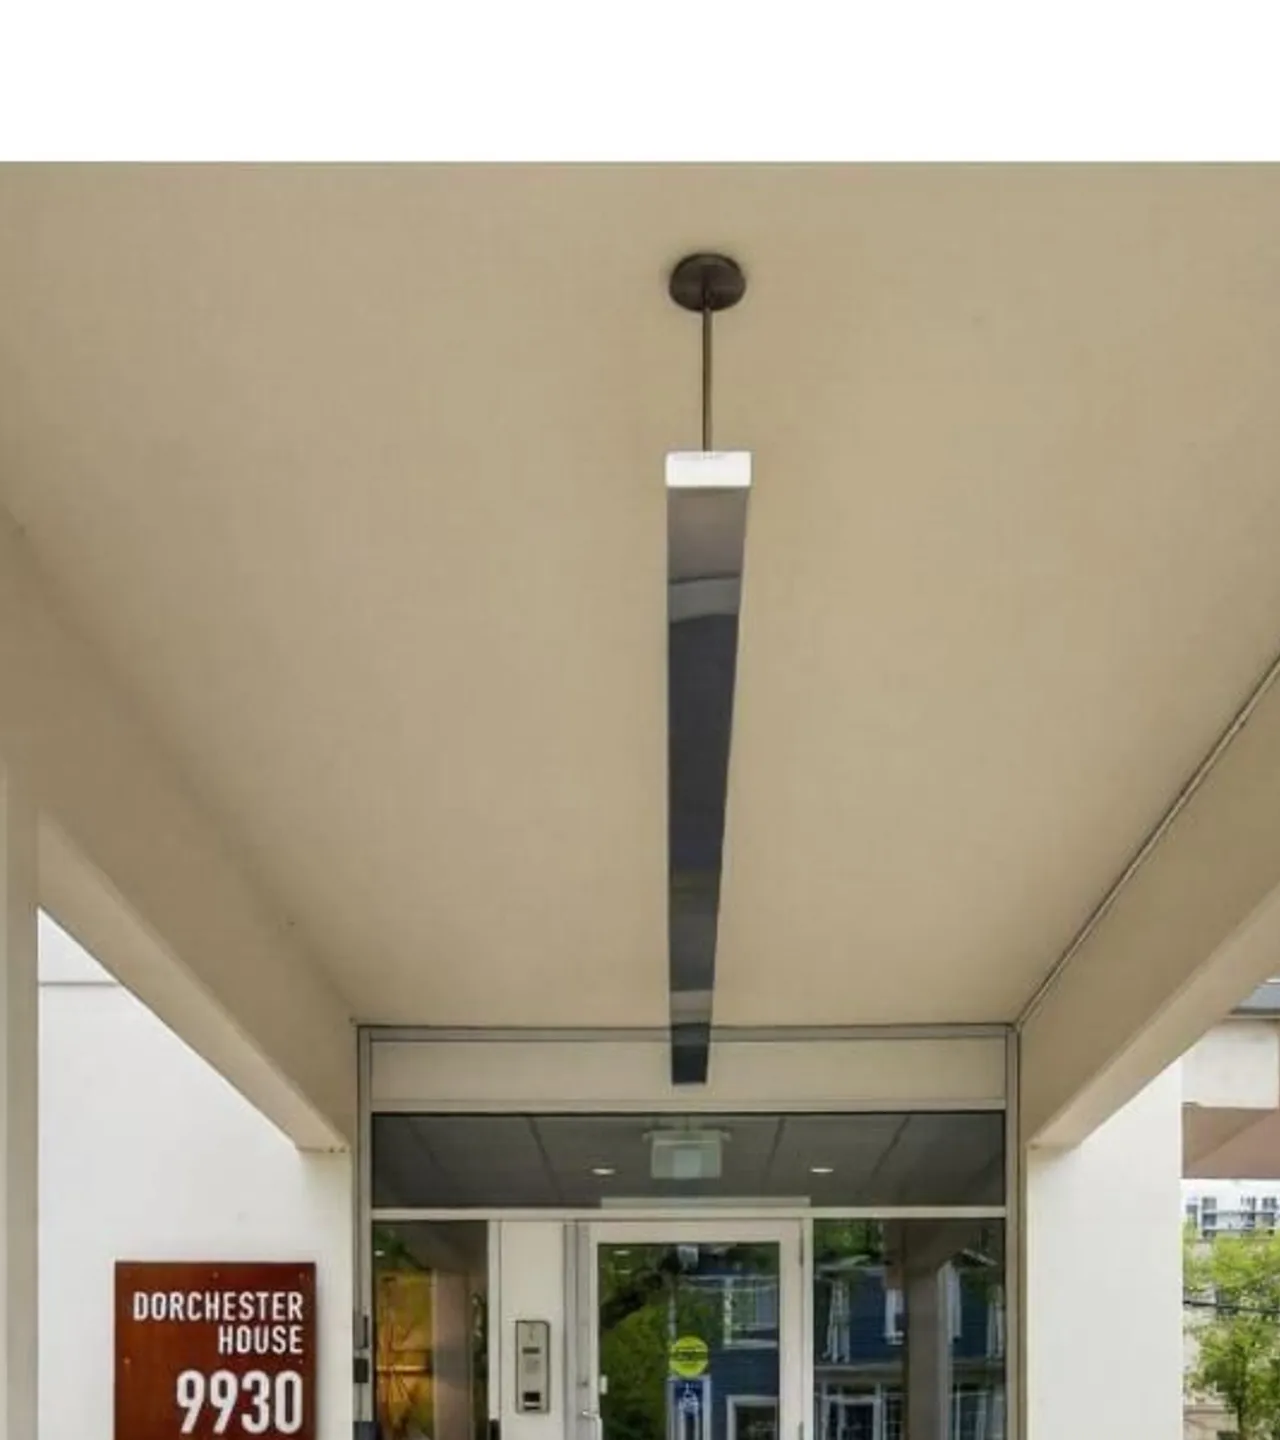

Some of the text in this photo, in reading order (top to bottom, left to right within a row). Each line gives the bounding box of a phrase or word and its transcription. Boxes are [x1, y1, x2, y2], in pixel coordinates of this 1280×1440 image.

[133, 1291, 303, 1321] DORCHESTER
[218, 1325, 303, 1354] HOUSE
[176, 1369, 303, 1434] 9930
